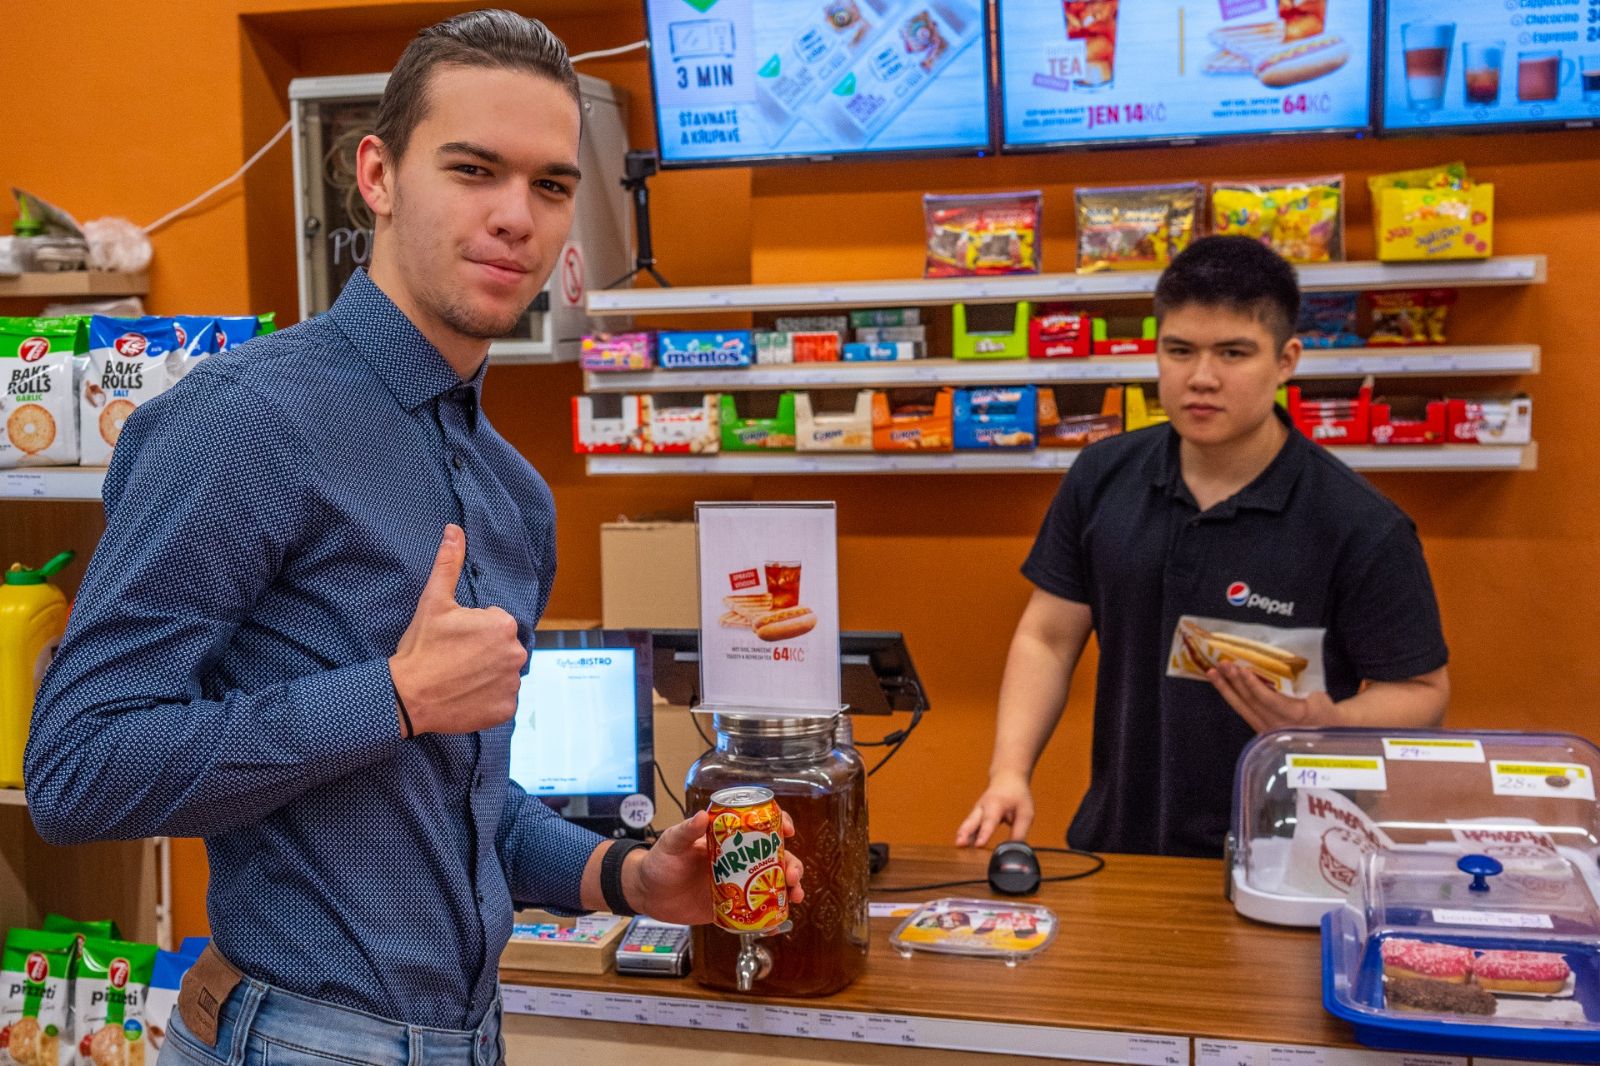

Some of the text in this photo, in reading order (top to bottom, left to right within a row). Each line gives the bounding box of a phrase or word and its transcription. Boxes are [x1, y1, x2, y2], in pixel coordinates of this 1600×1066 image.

[1048, 57, 1082, 77] TEA
[677, 64, 734, 89] 3 MIN
[1087, 105, 1119, 129] JEN
[681, 131, 690, 146] A
[666, 350, 741, 365] mentos
[12, 364, 50, 381] BAKE
[105, 360, 144, 376] BAKE
[7, 377, 52, 395] ROLLS
[101, 375, 144, 389] ROLLS
[1247, 593, 1295, 617] pepsi
[580, 657, 612, 666] BISTRO
[1297, 769, 1318, 785] 19
[712, 832, 781, 883] MIRINDA
[748, 857, 775, 875] ORANGE
